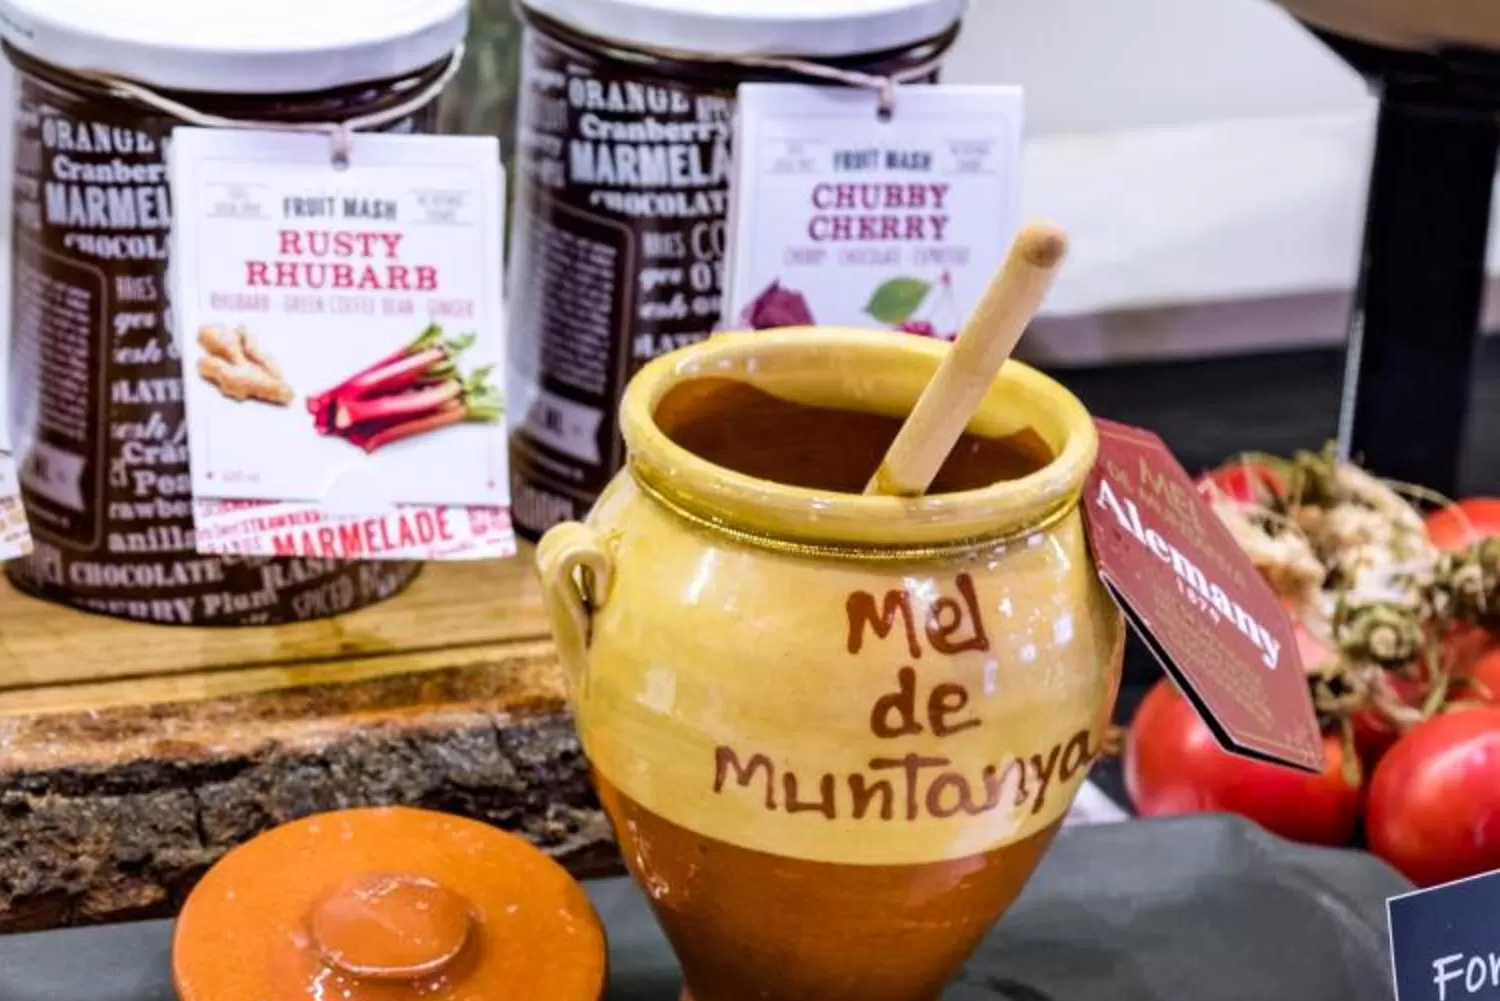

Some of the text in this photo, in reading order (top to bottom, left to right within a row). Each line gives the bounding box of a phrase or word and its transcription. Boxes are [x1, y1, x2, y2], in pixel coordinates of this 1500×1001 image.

[282, 196, 336, 219] FRUIT
[342, 198, 398, 221] MASH
[811, 182, 950, 210] CHUBBY
[277, 229, 404, 259] RUSTY
[807, 214, 949, 242] CHERRY
[244, 261, 439, 291] RHUBARB
[271, 503, 453, 559] MARMELADE
[1097, 478, 1281, 672] Alemany
[845, 572, 990, 660] Mel
[870, 666, 983, 740] de
[712, 729, 1099, 822] Muntanya
